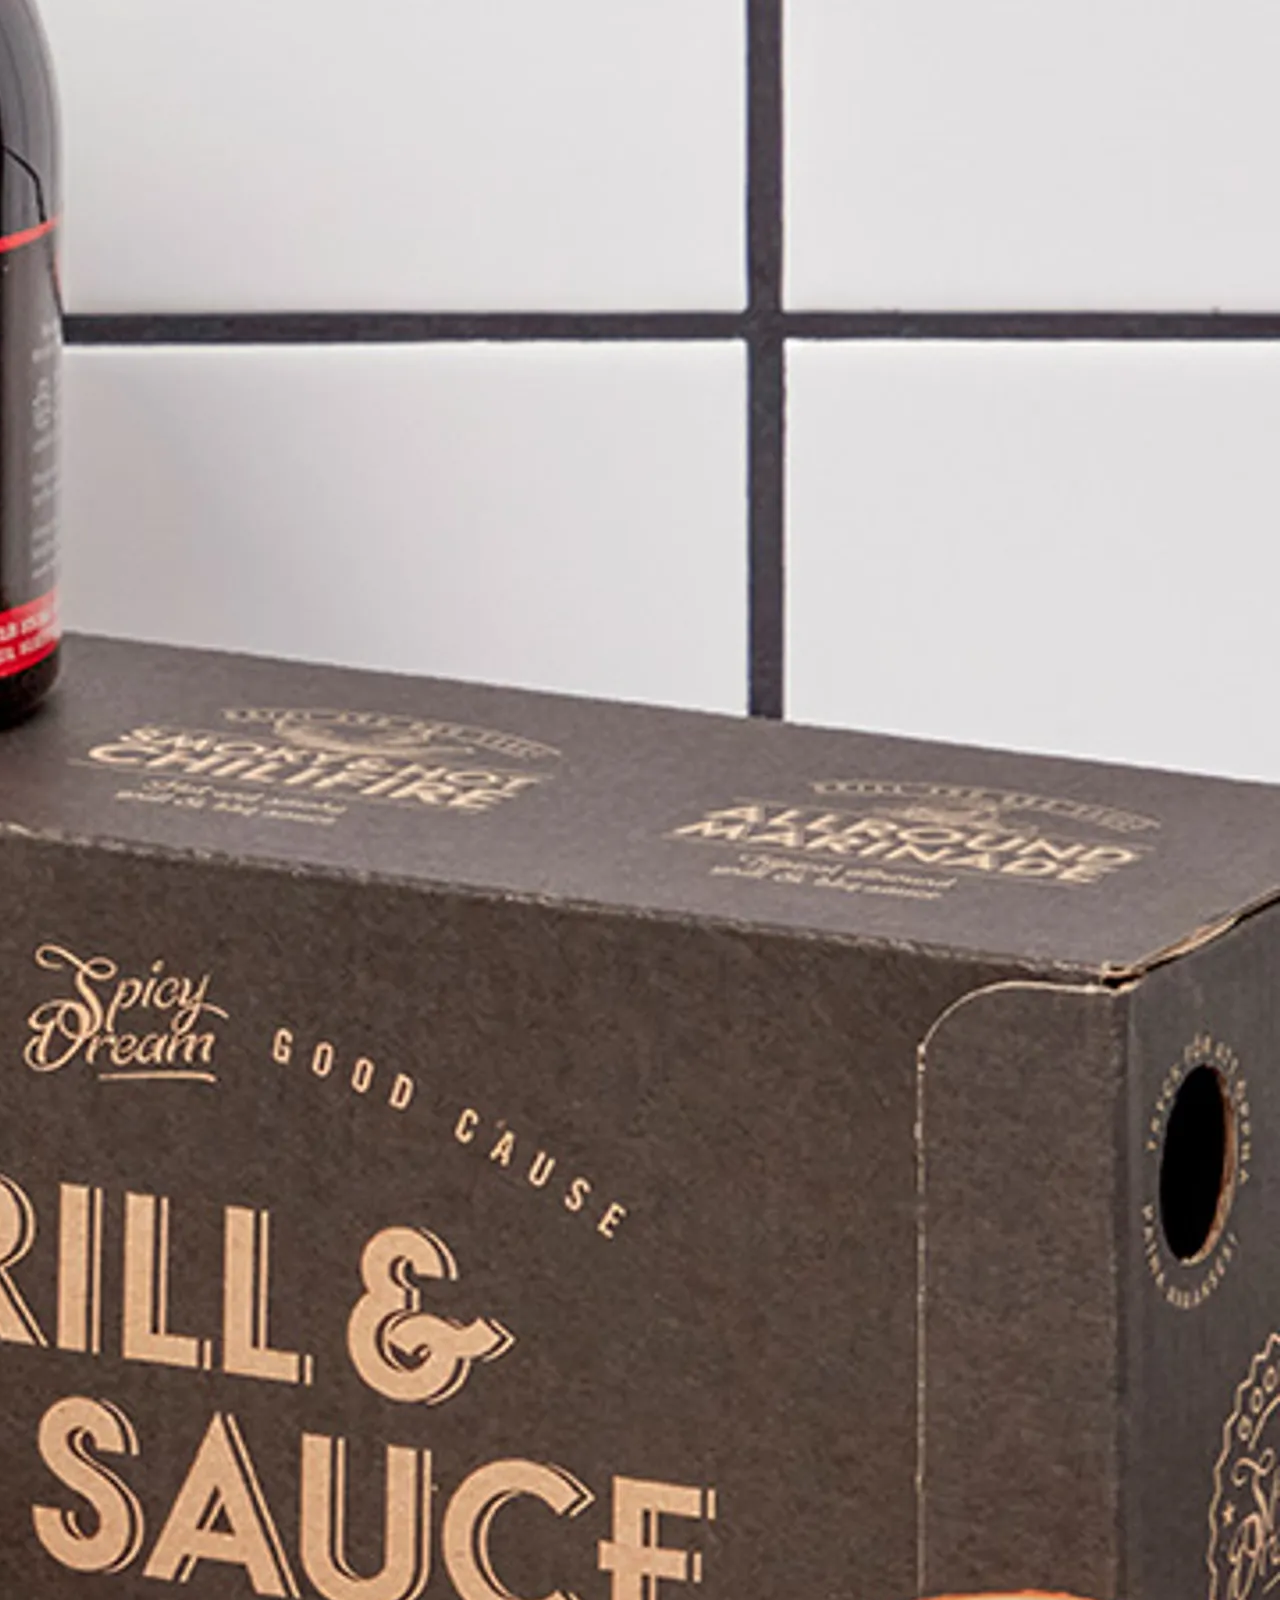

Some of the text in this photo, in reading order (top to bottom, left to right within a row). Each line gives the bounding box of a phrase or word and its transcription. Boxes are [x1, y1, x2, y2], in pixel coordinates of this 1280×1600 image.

[24, 999, 216, 1073] Dream
[35, 944, 229, 1040] Spicy
[271, 1027, 627, 1239] GOOD CAUSE
[347, 1227, 515, 1402] &
